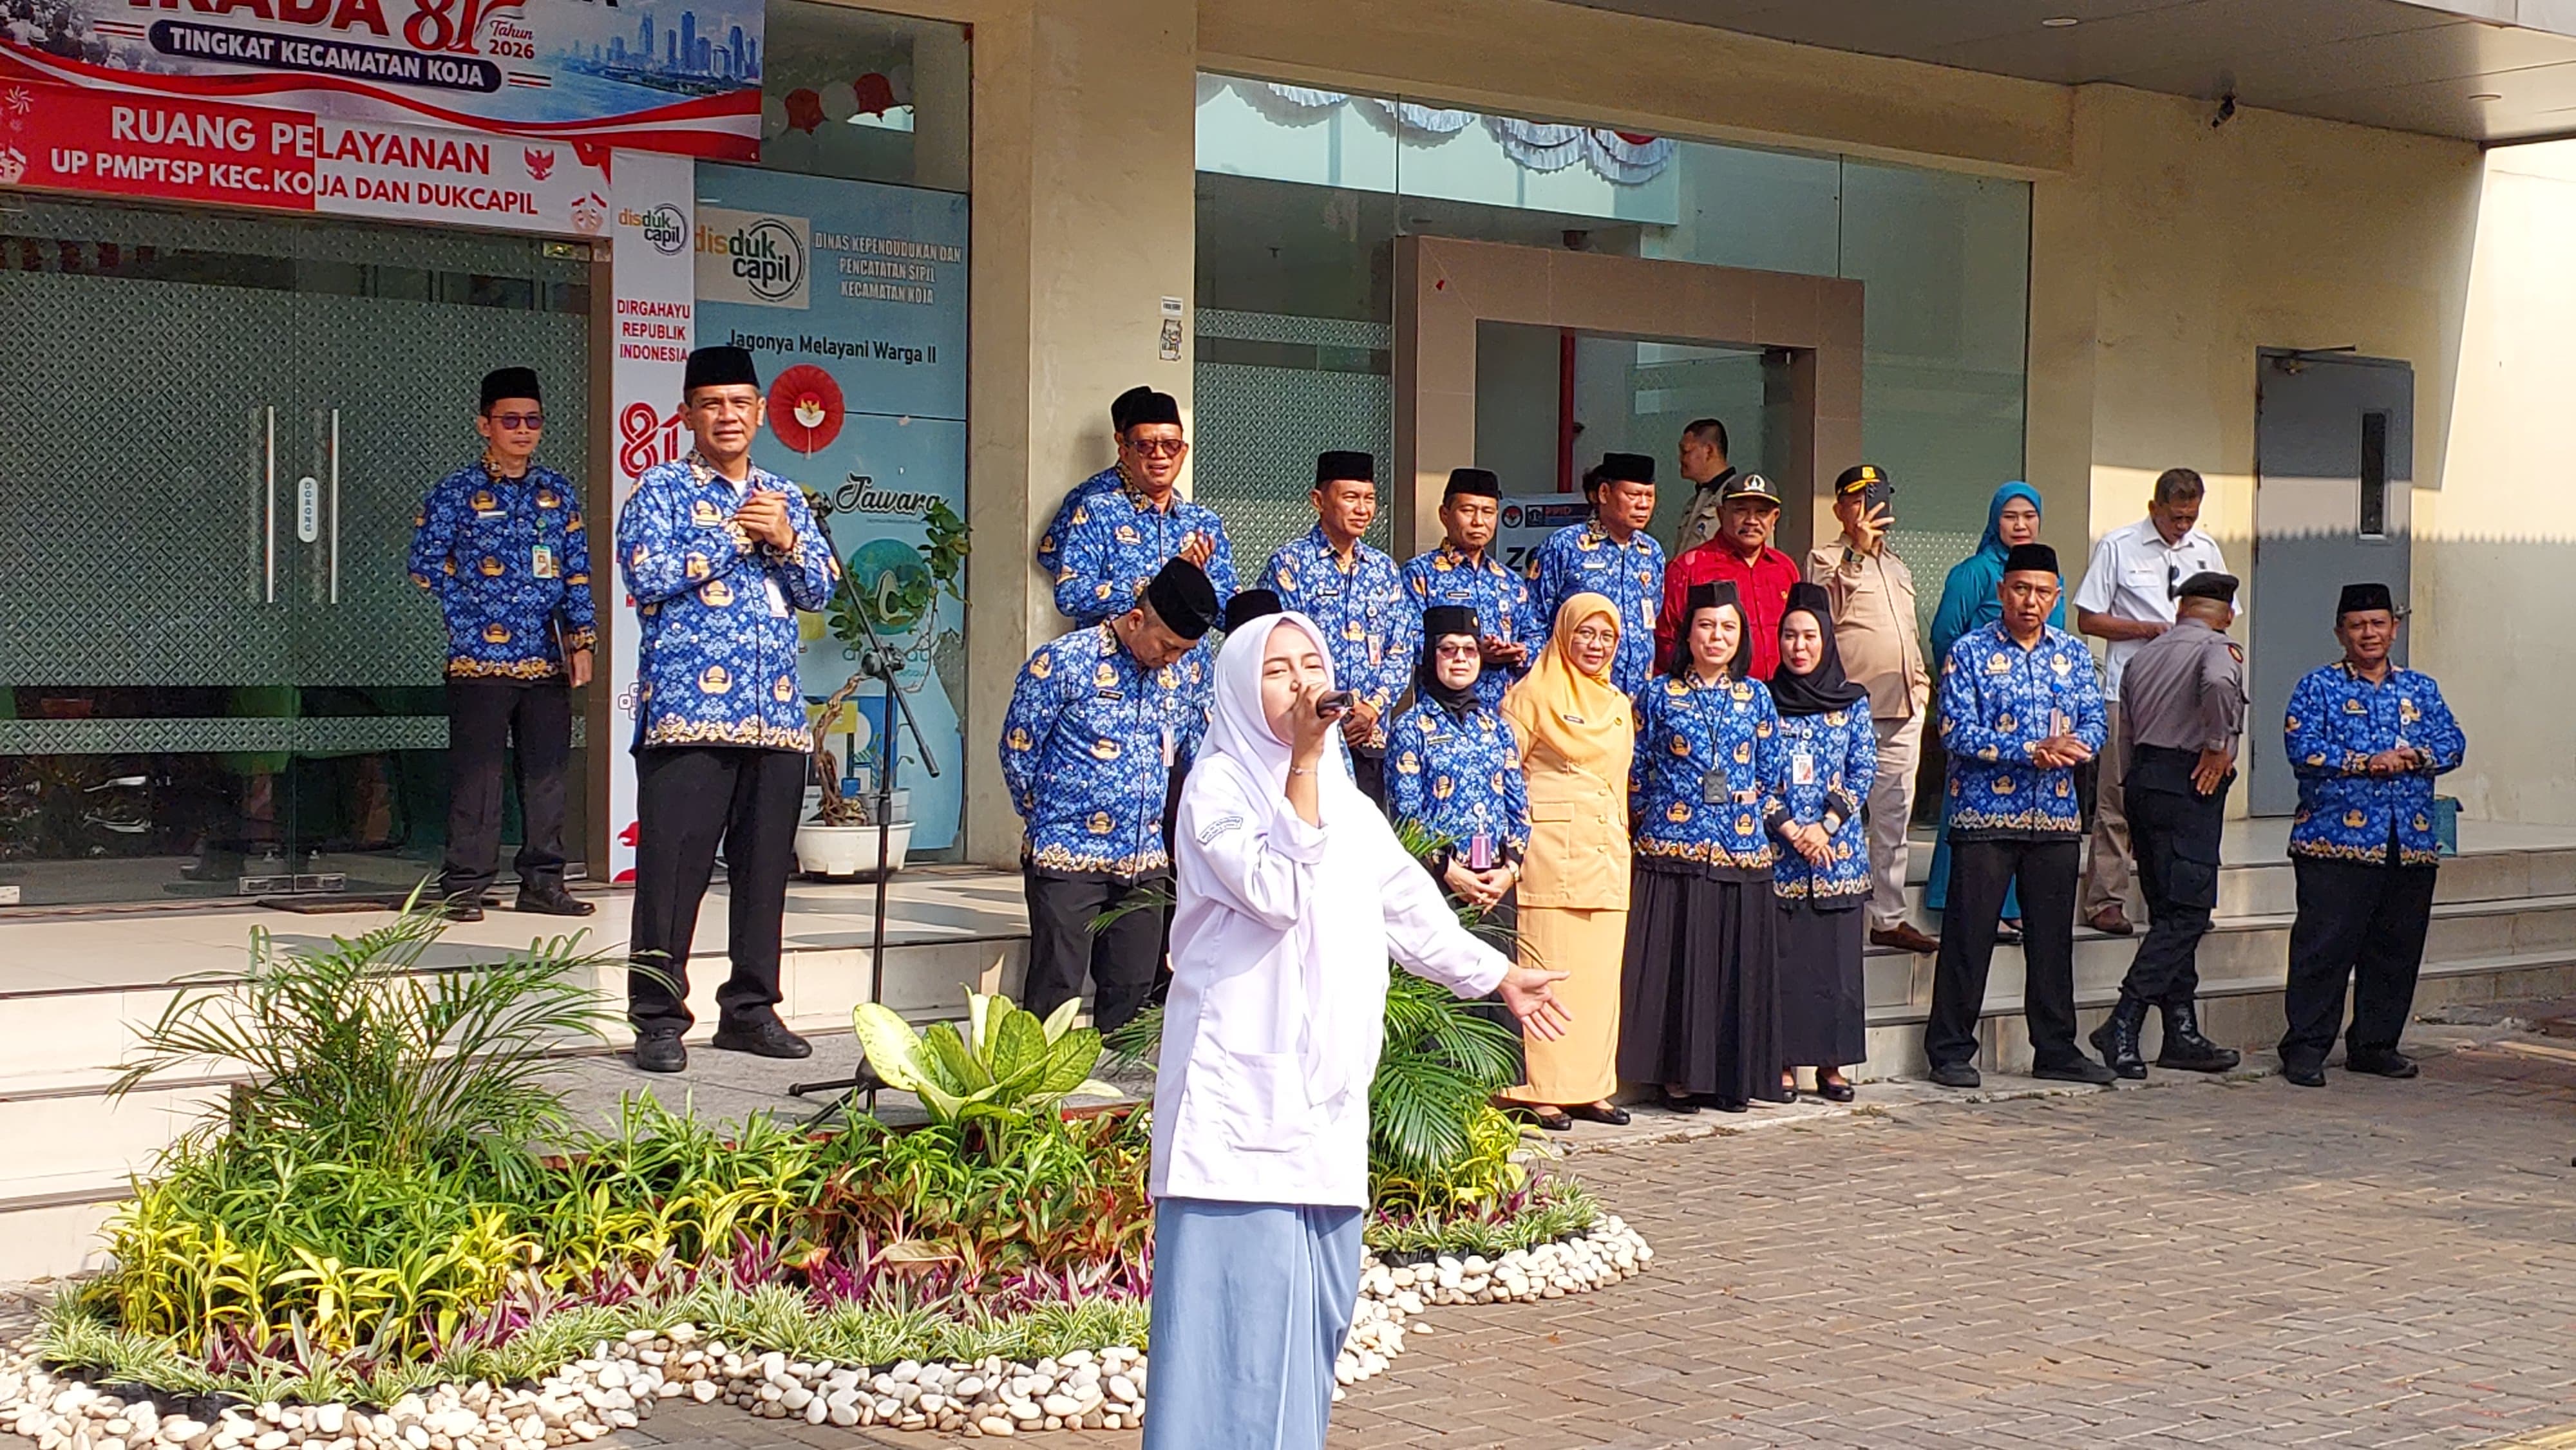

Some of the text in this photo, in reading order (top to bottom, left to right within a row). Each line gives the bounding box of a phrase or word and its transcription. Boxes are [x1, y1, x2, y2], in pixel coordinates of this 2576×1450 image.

[490, 20, 533, 41] Tahun
[169, 26, 484, 87] TINGKAT KECAMATAN KOJA
[489, 39, 535, 59] 2026
[111, 106, 489, 175] RUANG PELAYANAN
[51, 148, 88, 174] UP
[96, 153, 204, 184] PMPTSP
[355, 177, 409, 203] DAN
[418, 182, 538, 215] DUKCAPIL
[645, 226, 680, 247] capil
[815, 232, 962, 263] DINAS KEPENDUDUKAN DAN
[733, 254, 791, 288] capil
[839, 258, 936, 283] PENCATATAN SIPIL
[840, 281, 934, 305] KECAMATAN KOJA
[617, 299, 690, 319] DIRGAHAYU
[623, 322, 686, 341] REPUBLIK
[620, 343, 688, 362] INDONESIA
[726, 329, 793, 355] Jagonya
[799, 334, 869, 360] Melayani
[873, 340, 922, 365] Warga
[304, 482, 312, 532] DORONG
